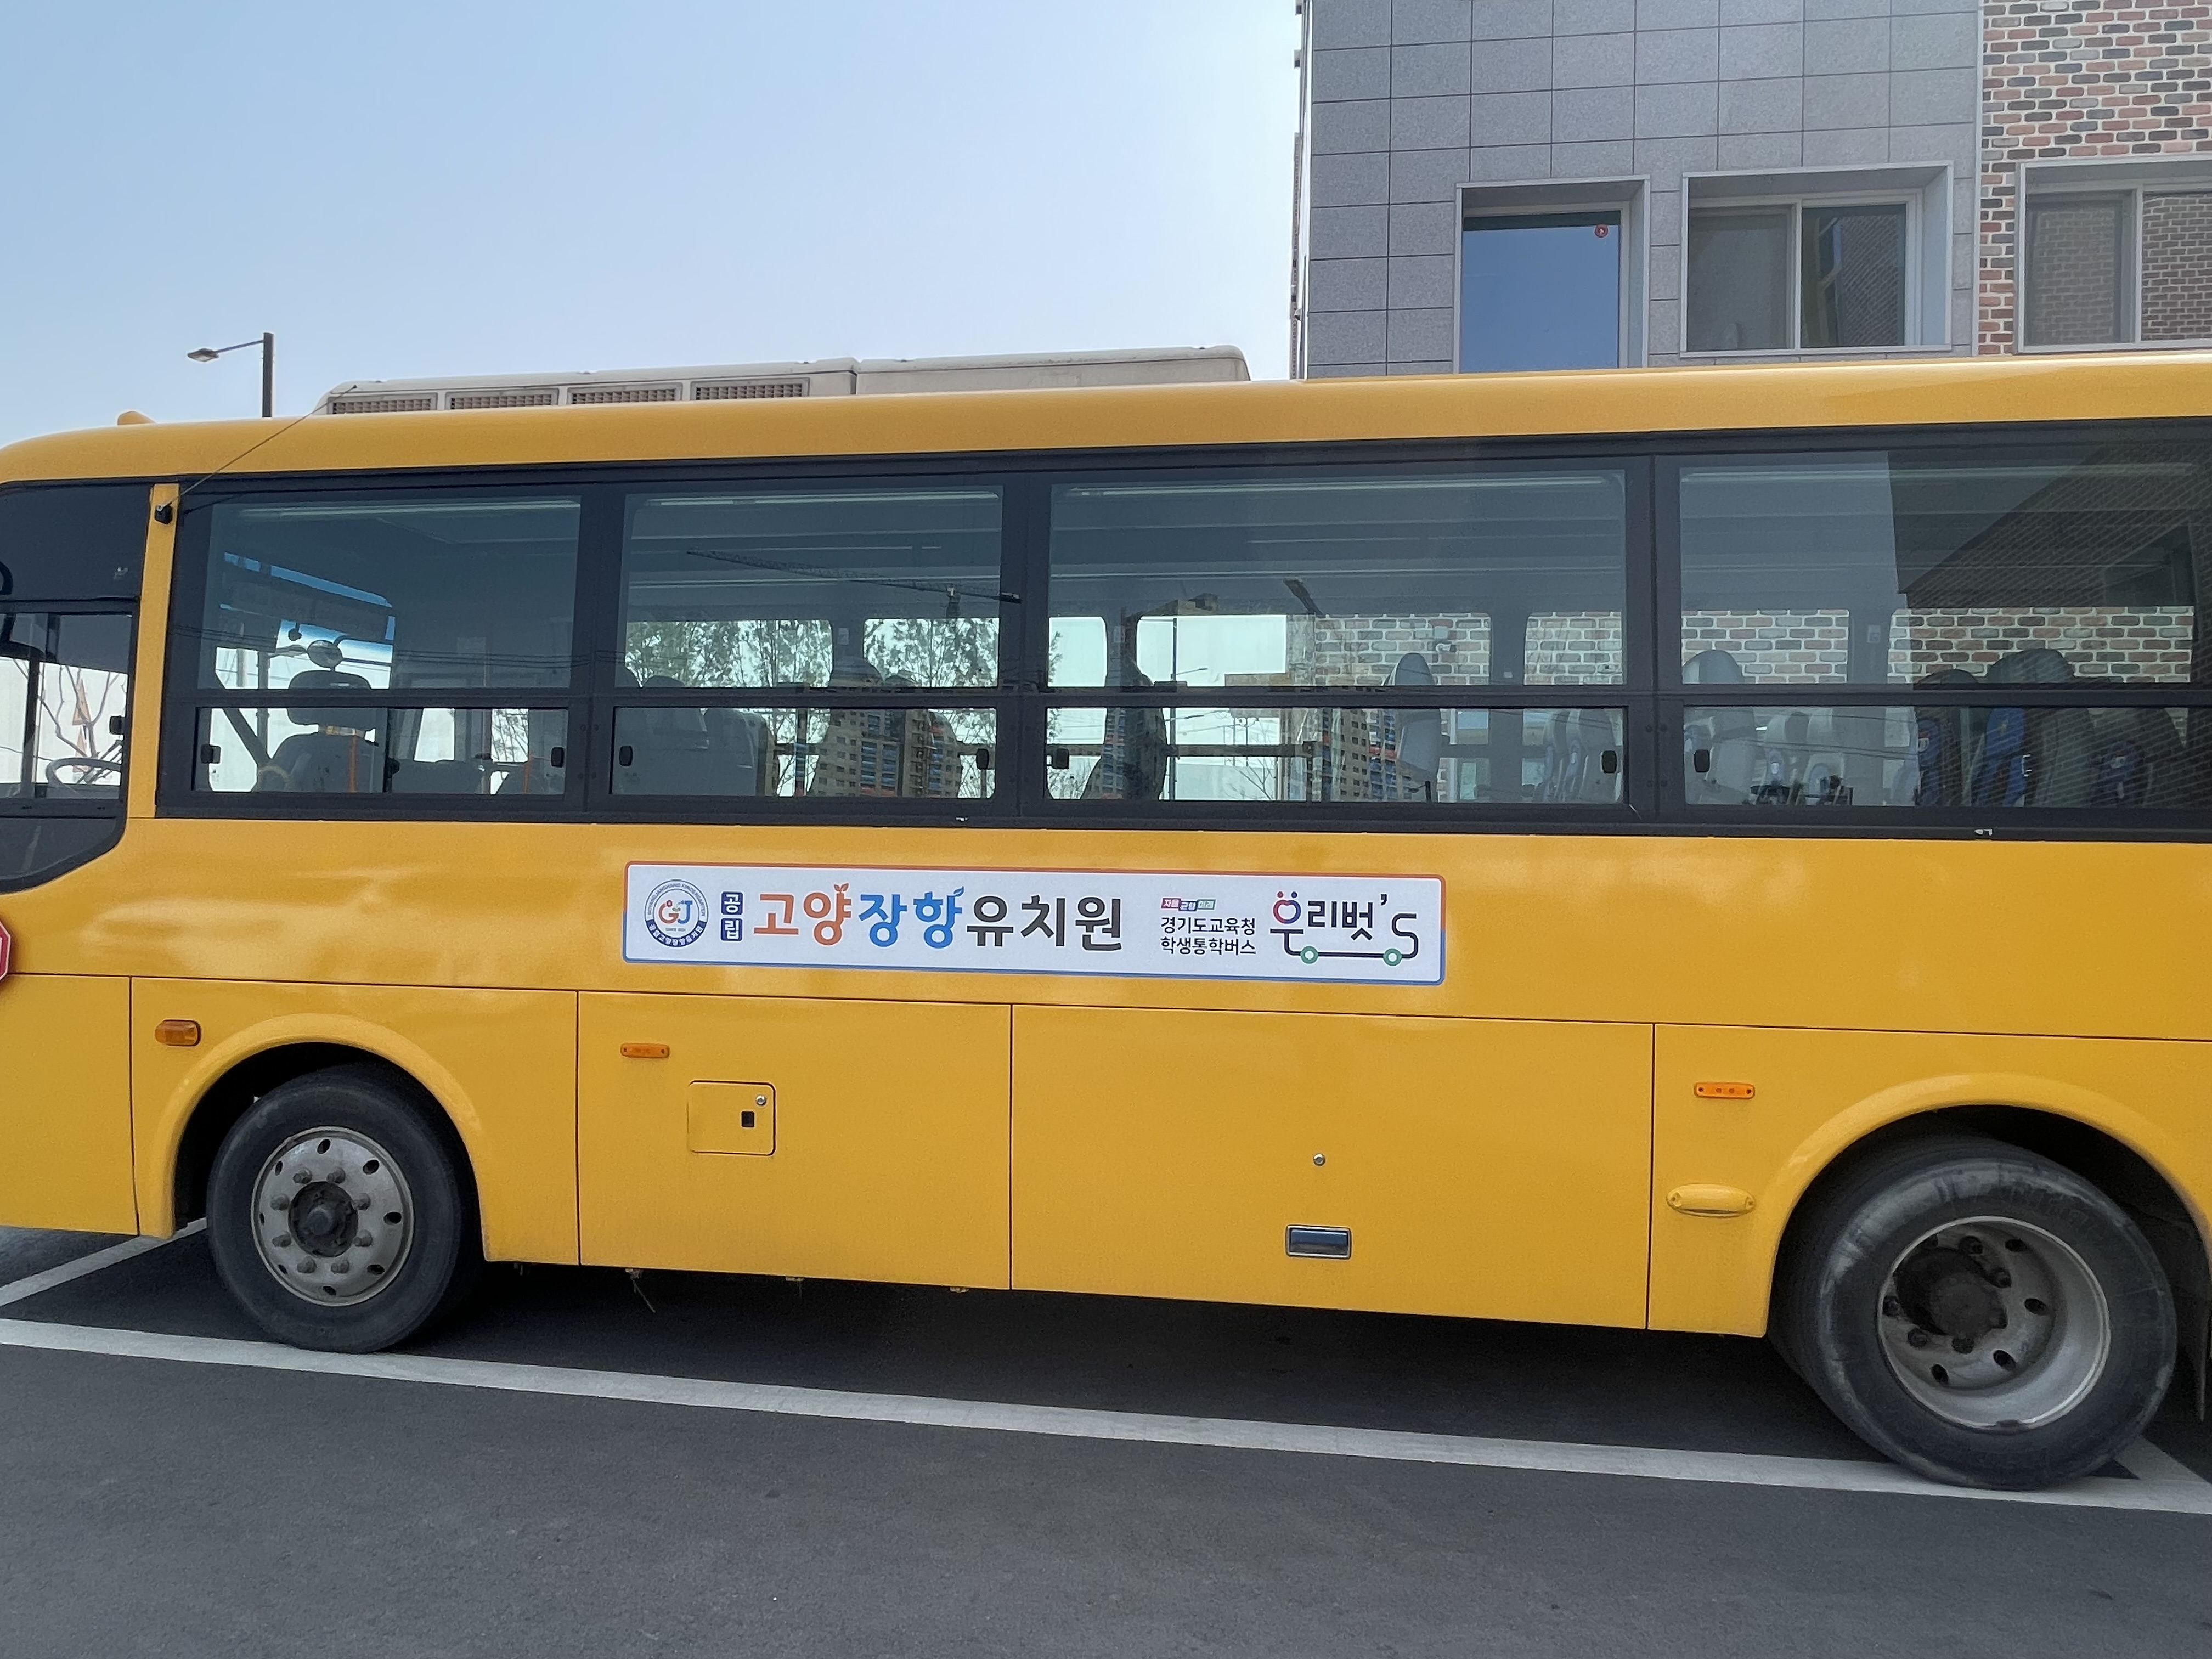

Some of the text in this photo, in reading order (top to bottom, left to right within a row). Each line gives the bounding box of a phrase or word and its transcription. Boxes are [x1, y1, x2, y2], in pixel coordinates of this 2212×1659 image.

[658, 900, 693, 924] GJ
[724, 894, 741, 939] 공립
[754, 884, 1122, 951] 고양장항유치원
[1161, 916, 1255, 935] 경기도교육청
[1160, 936, 1256, 956] 학생통학버스
